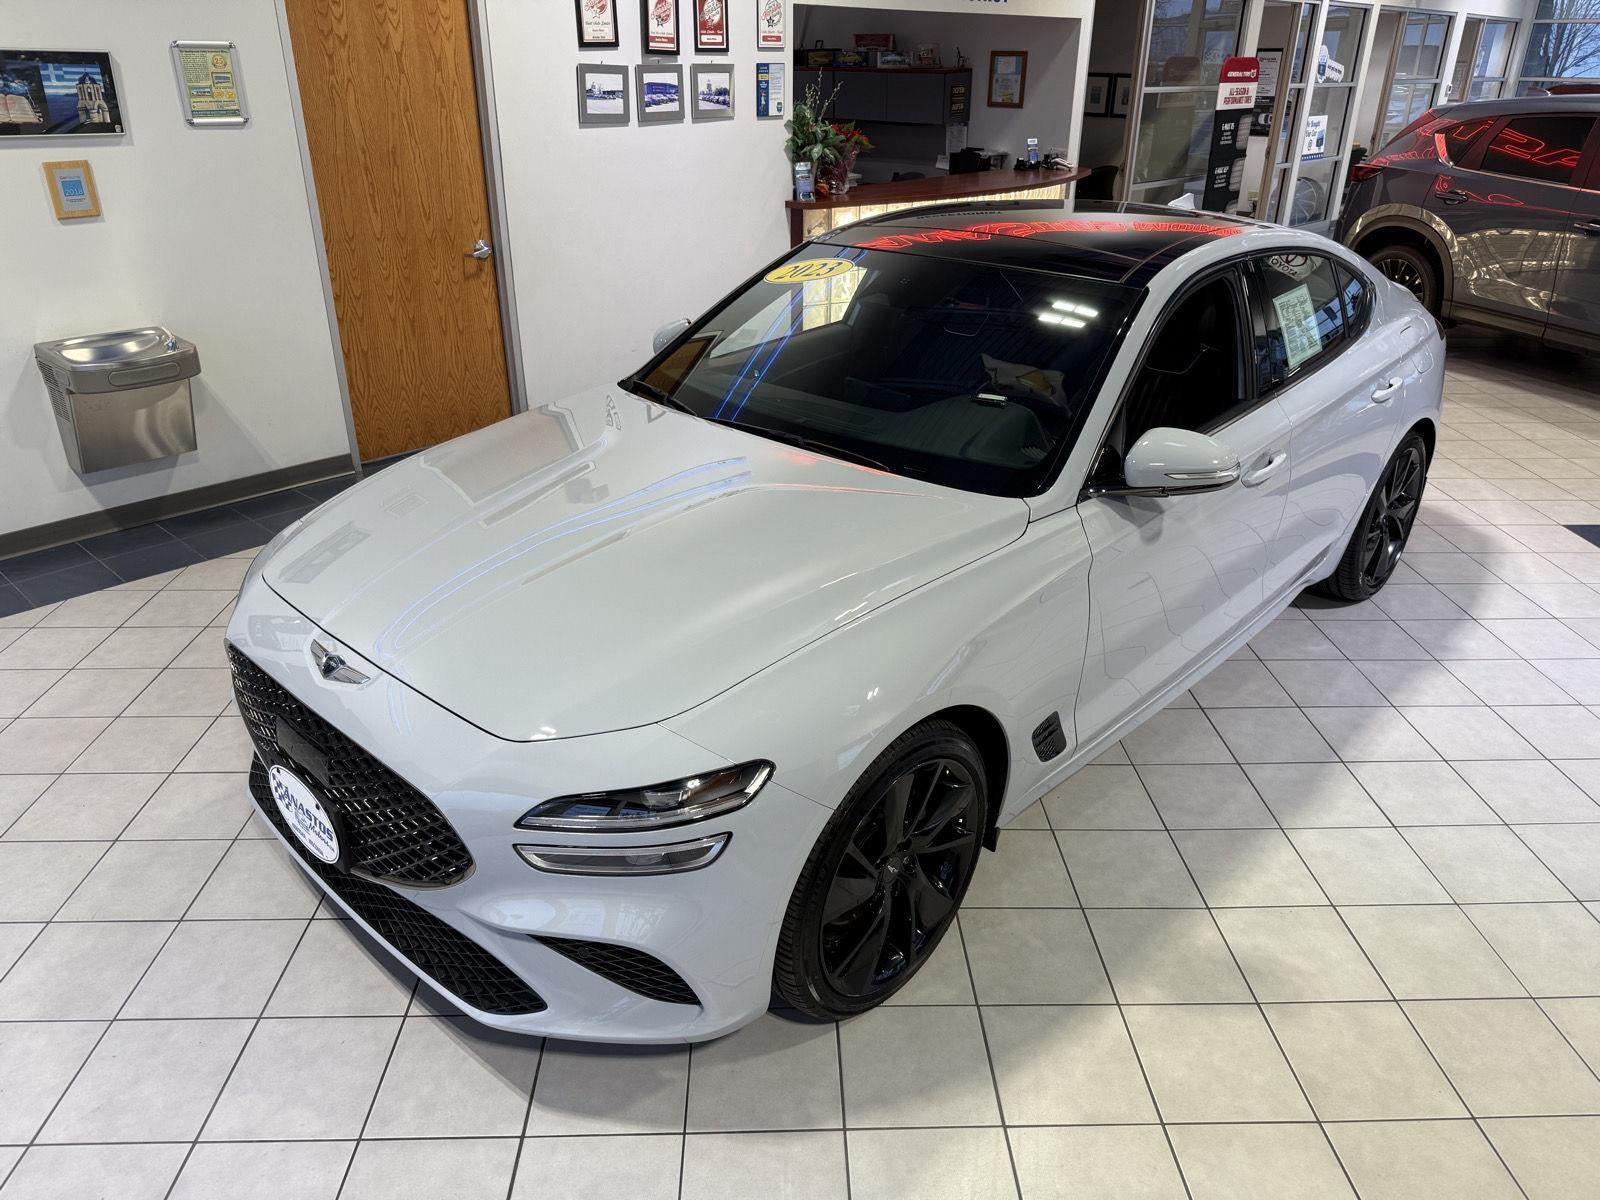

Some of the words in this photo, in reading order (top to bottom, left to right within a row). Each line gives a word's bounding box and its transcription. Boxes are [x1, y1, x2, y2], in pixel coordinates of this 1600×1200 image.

[773, 261, 843, 280] 2023
[1270, 256, 1298, 277] OYOTA
[283, 786, 335, 842] ANASTOS
